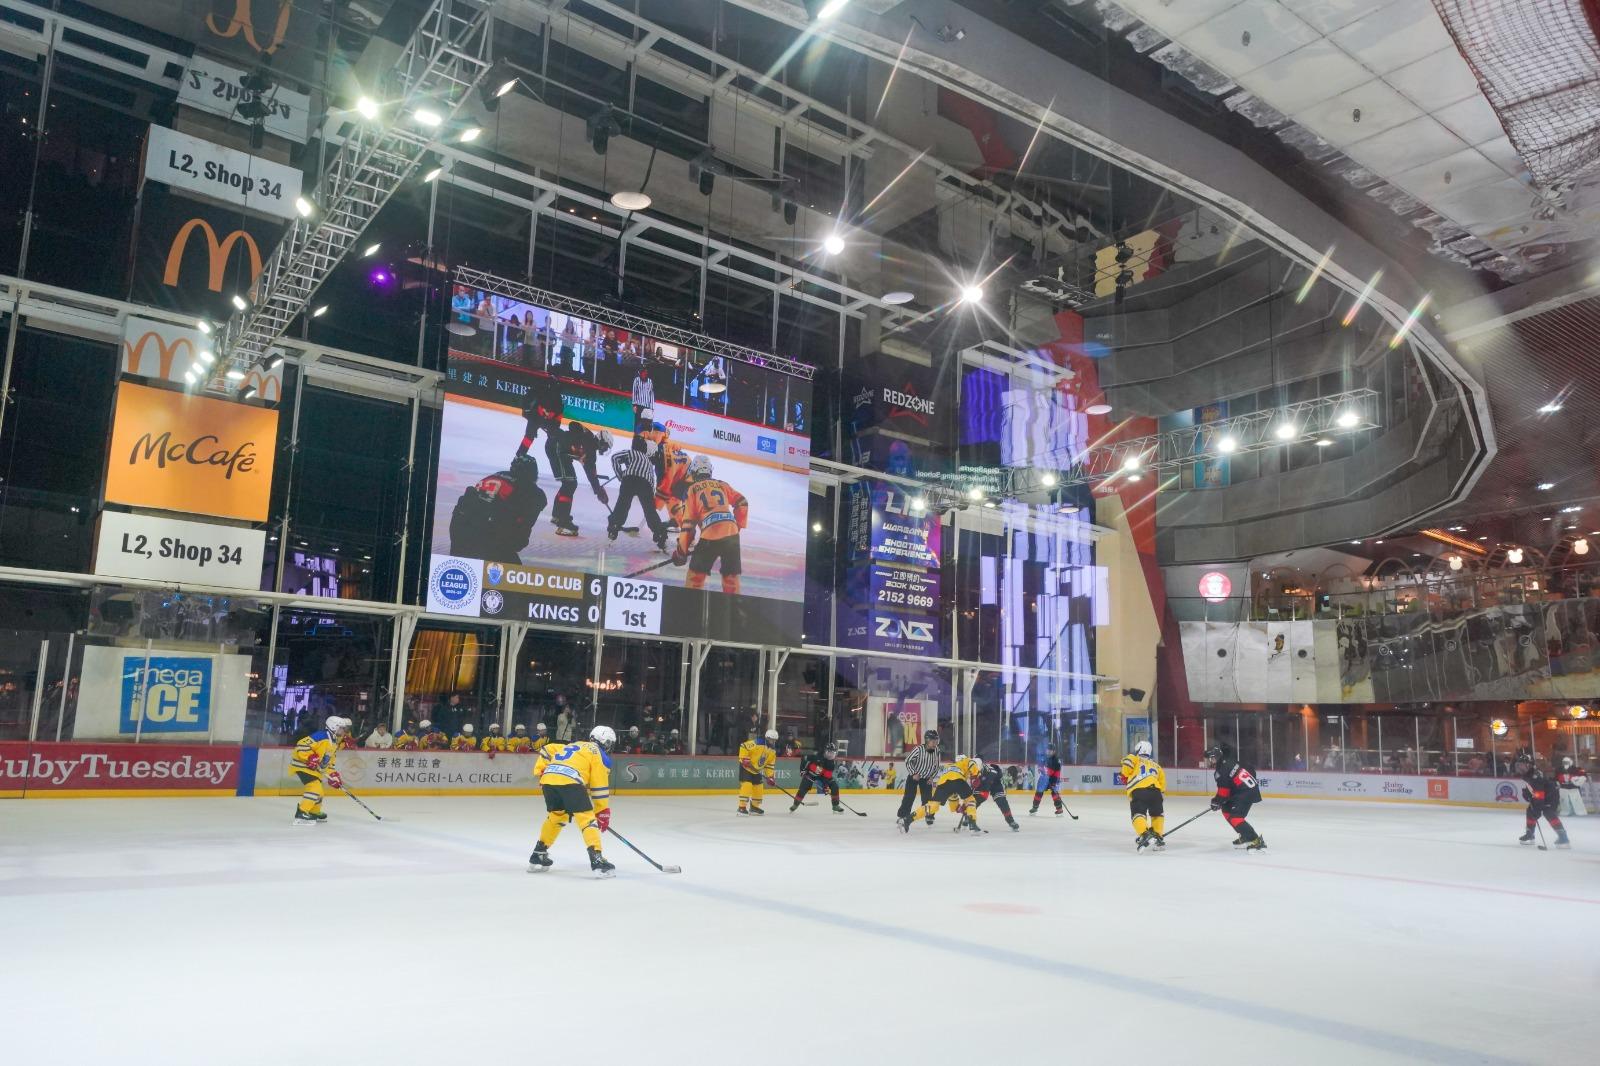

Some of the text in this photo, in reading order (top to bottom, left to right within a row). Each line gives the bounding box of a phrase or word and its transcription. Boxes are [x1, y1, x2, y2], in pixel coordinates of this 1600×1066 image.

[168, 149, 282, 200] L2, Shop 34
[495, 378, 531, 397] KERR
[883, 387, 935, 415] REDZONE
[712, 428, 741, 444] MELONA
[129, 431, 257, 480] McCafé
[121, 532, 243, 568] L2, Shop 34
[878, 544, 932, 561] EXPERIENCE
[884, 537, 927, 552] SHOOTING
[441, 580, 468, 590] LEAGUE
[446, 573, 464, 582] CLUB
[506, 569, 602, 596] GOLD CLUB 6
[885, 580, 928, 593] BOOK NOW
[613, 581, 658, 602] 02:25
[877, 589, 934, 608] 2152 9669
[528, 602, 599, 623] KINGS 0
[621, 609, 647, 628] 1st
[133, 666, 203, 688] mega
[80, 753, 234, 785] Tuesday
[377, 757, 441, 769] 香格里拉會
[375, 772, 513, 784] SHANGRI-LA CIRCLE
[705, 767, 736, 779] KERRY
